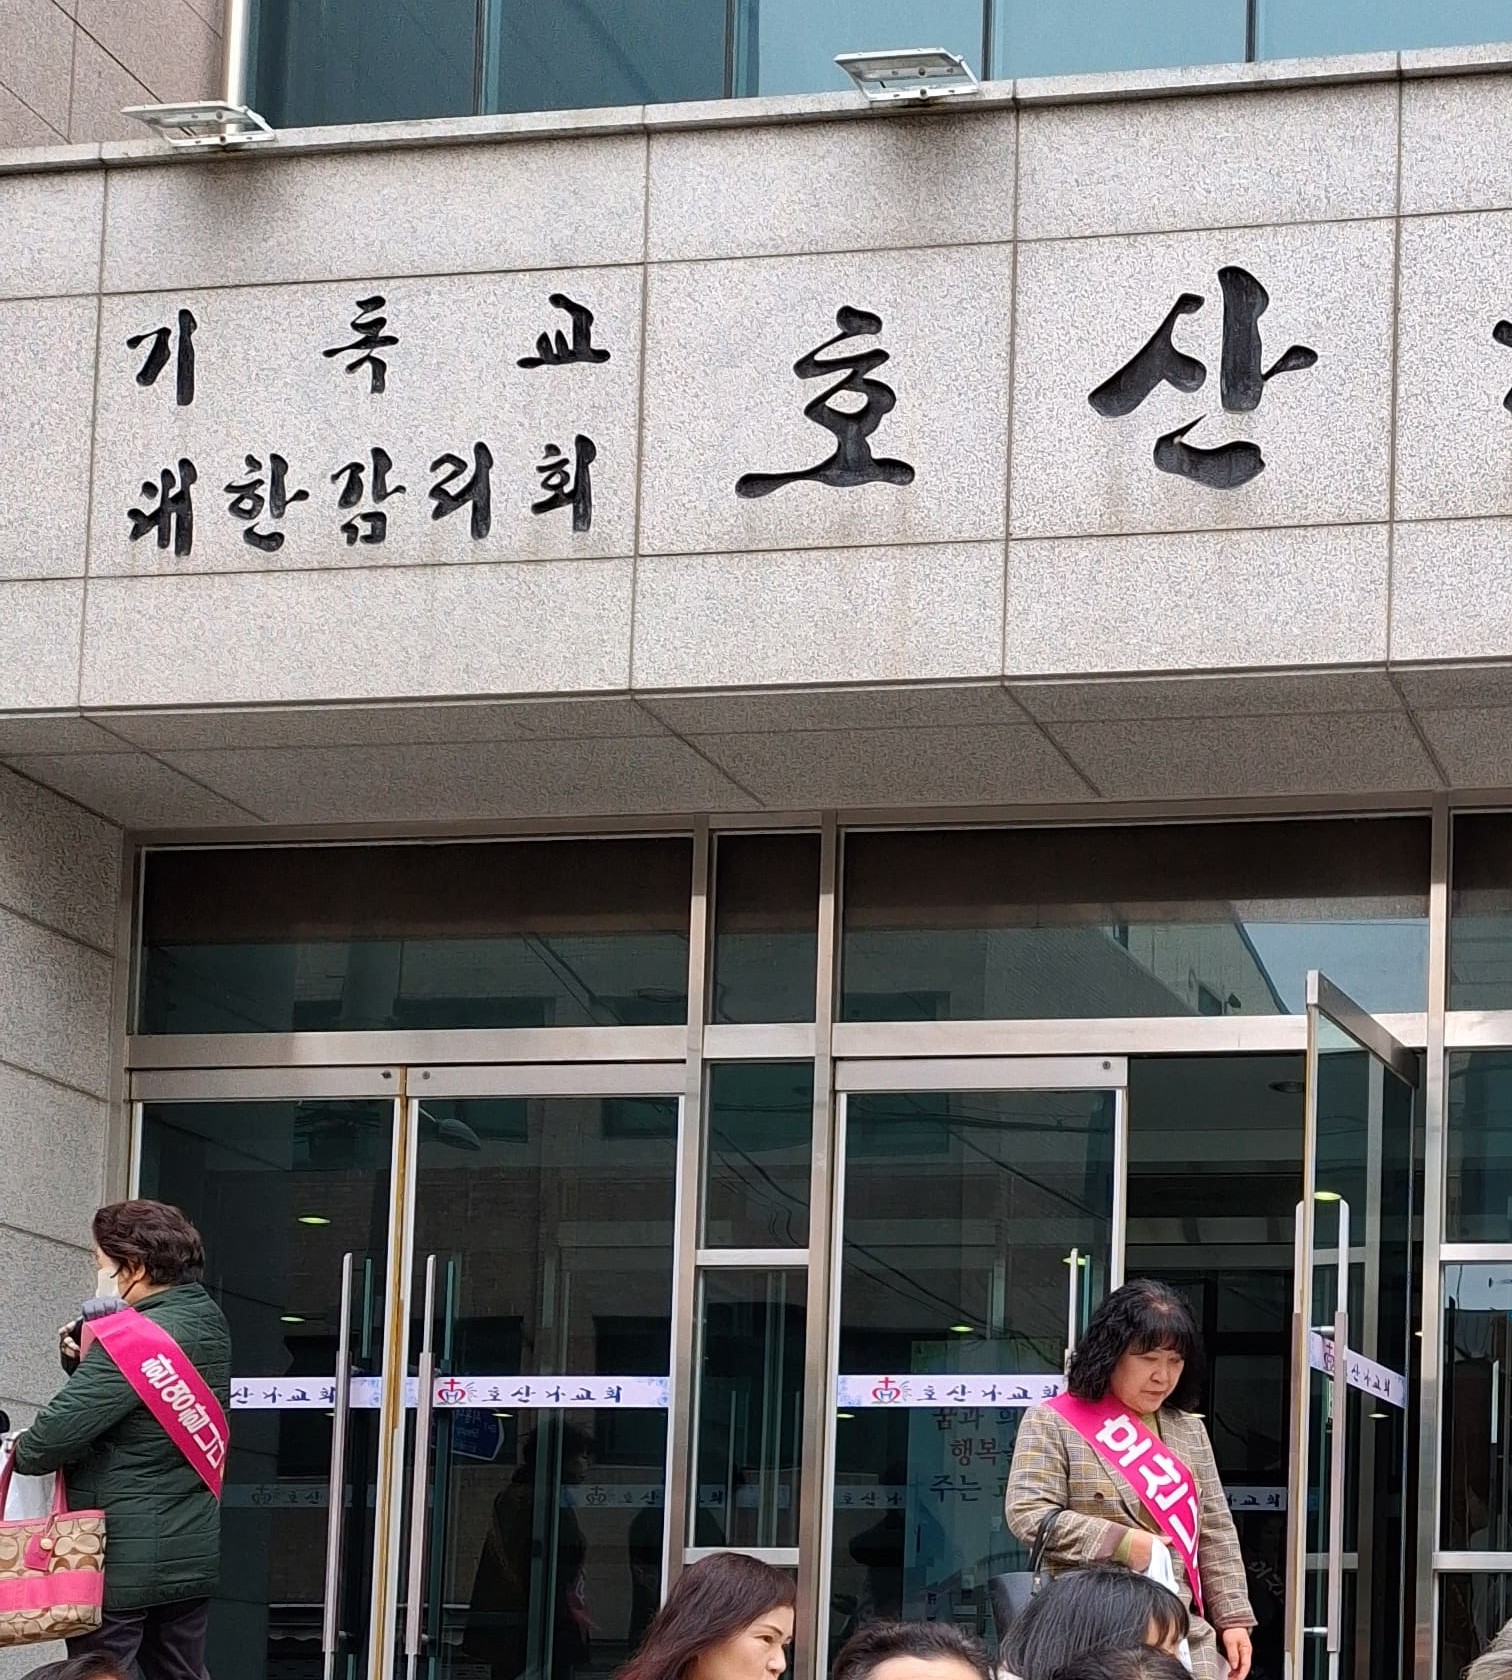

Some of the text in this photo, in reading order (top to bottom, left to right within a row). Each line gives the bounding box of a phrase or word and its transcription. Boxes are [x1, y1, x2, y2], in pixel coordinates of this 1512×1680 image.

[127, 294, 611, 406] 기독교
[127, 433, 597, 557] 대한감리회
[481, 1385, 622, 1403] 호산나교회
[917, 1384, 1059, 1402] 호산나교회
[929, 1474, 982, 1503] 주는
[1095, 1414, 1198, 1555] 호산나
